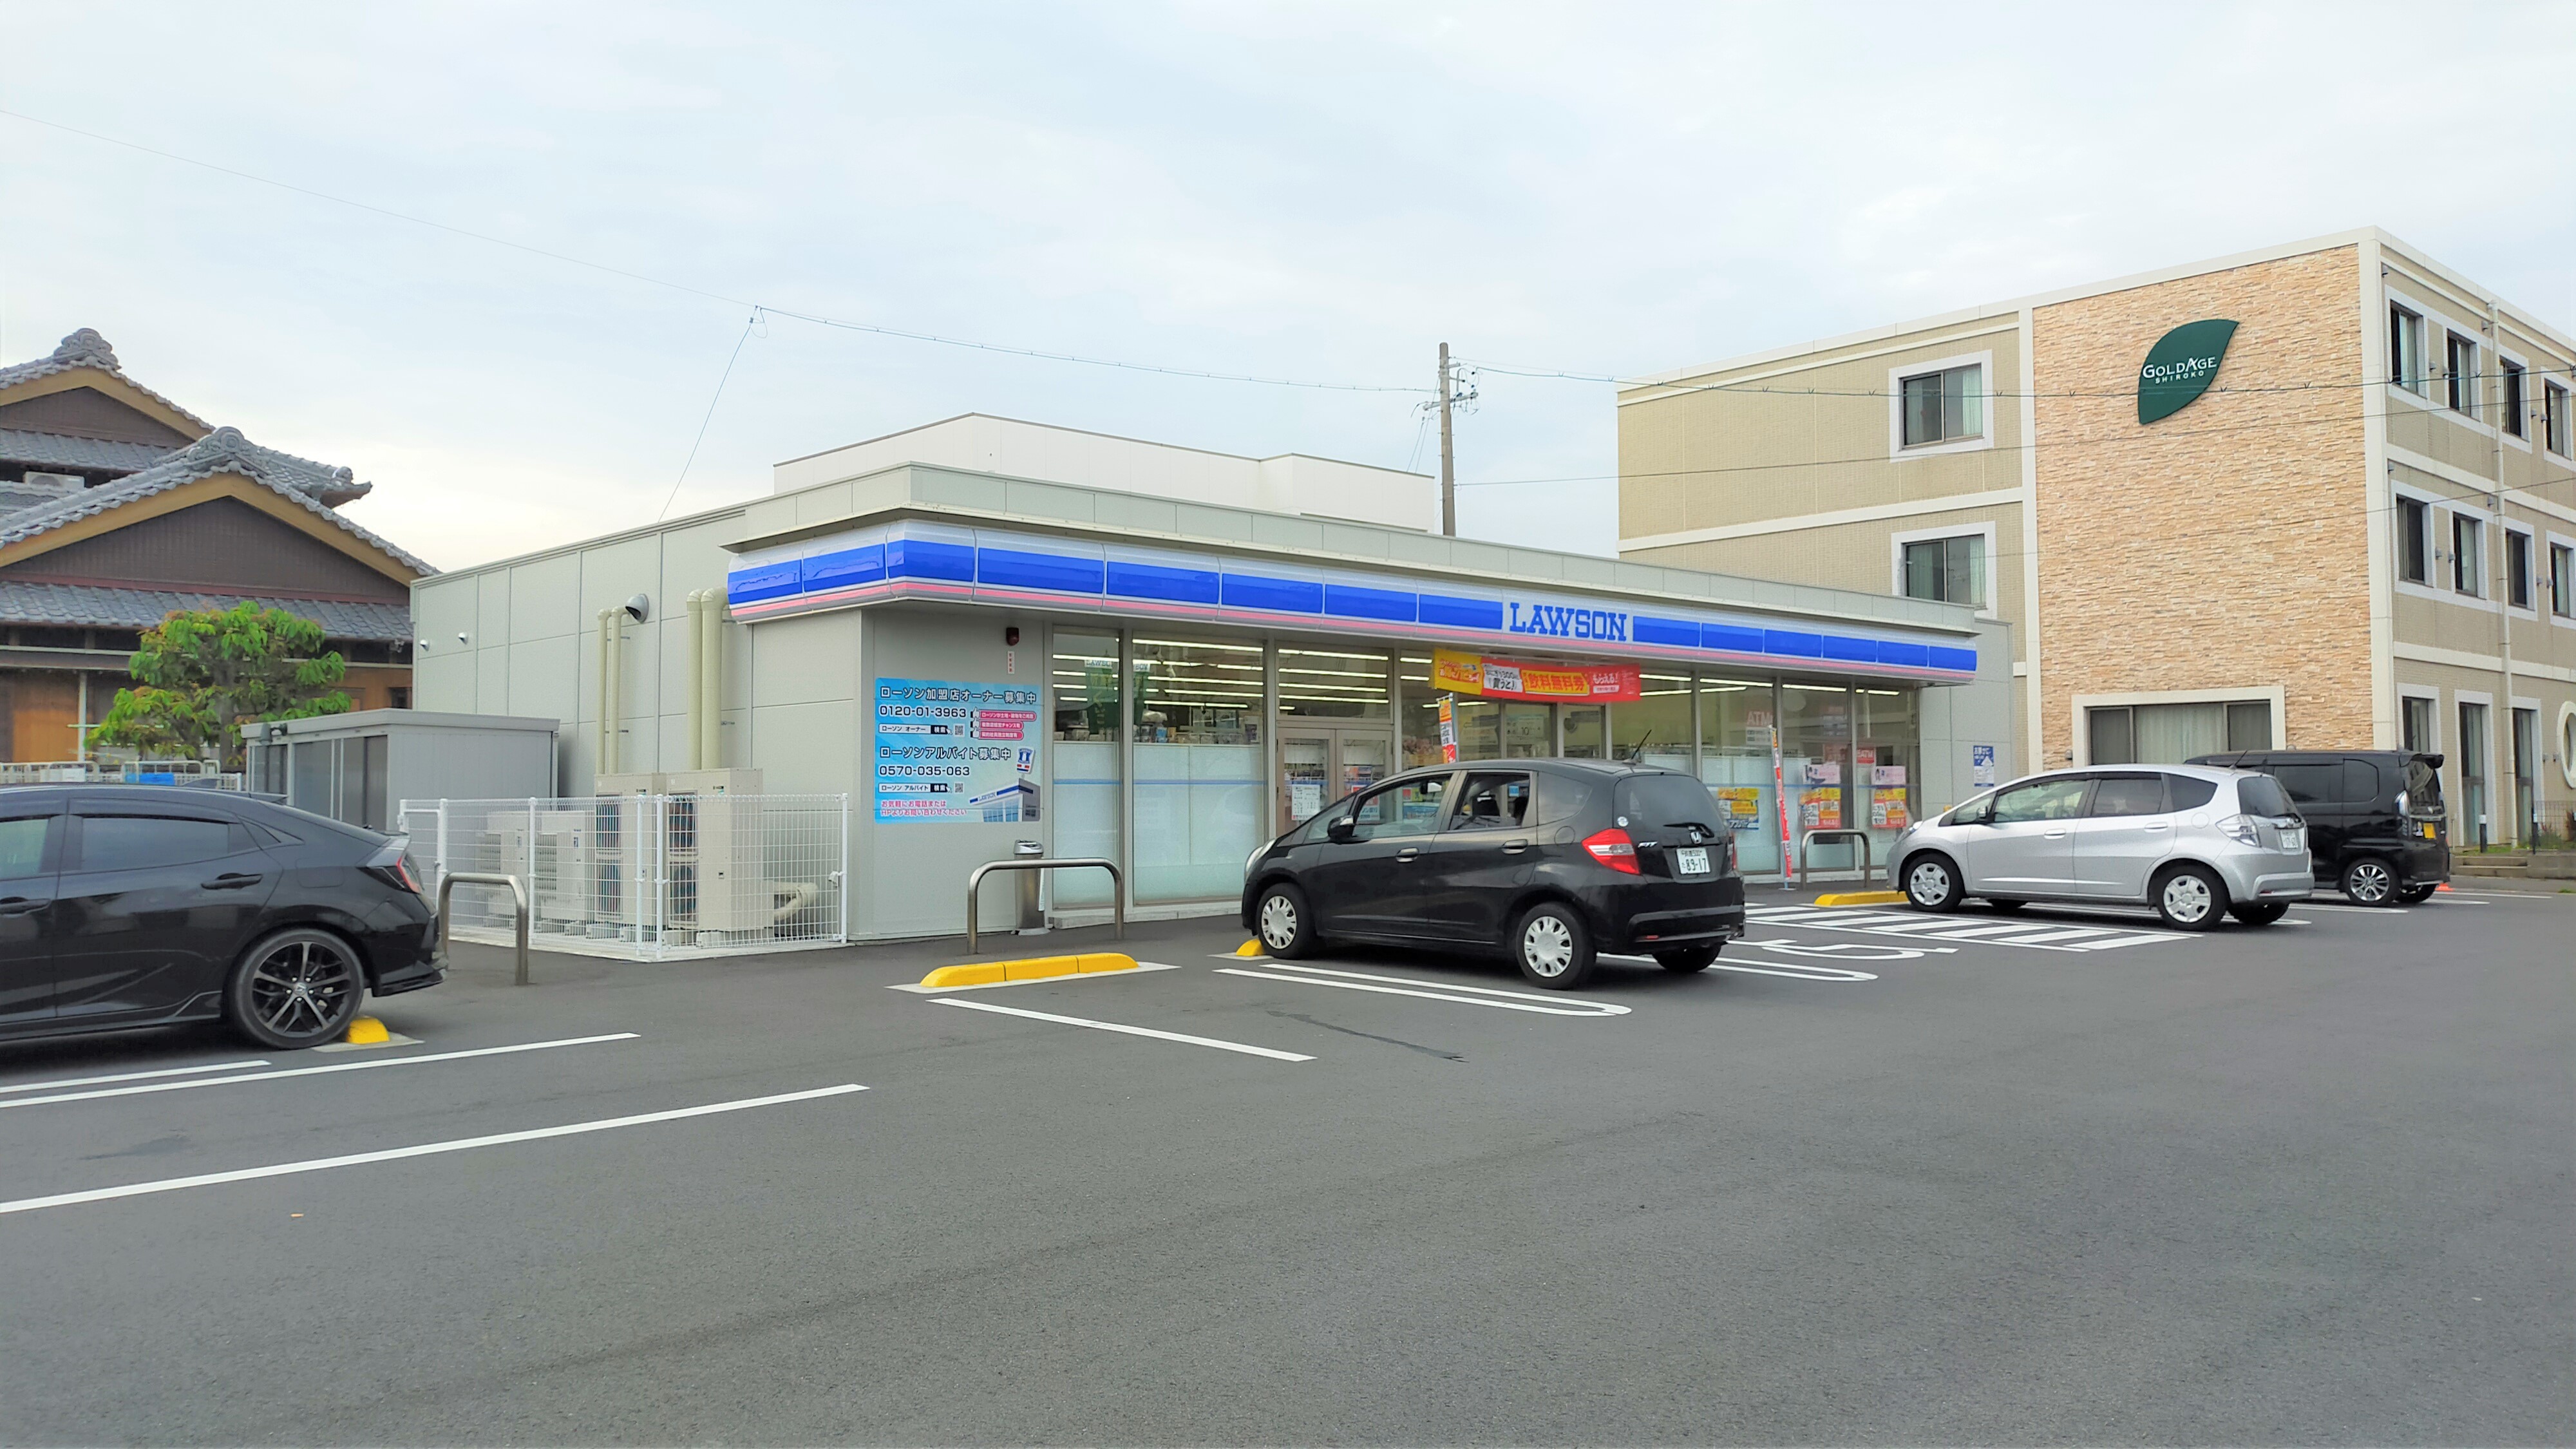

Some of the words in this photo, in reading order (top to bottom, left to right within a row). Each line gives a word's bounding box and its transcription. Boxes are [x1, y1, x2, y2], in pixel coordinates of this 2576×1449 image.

[2155, 370, 2204, 384] SHIROKO
[1510, 601, 1627, 642] LAWSON
[880, 687, 1036, 705] ローソン加盟店オーナー募集中
[879, 705, 967, 718] 0120-01-3963
[880, 746, 1011, 761] ローソンアルバイト募集中
[879, 765, 971, 776] 0570-035-063
[933, 784, 946, 792] 検索
[1686, 858, 1707, 871] 89-17
